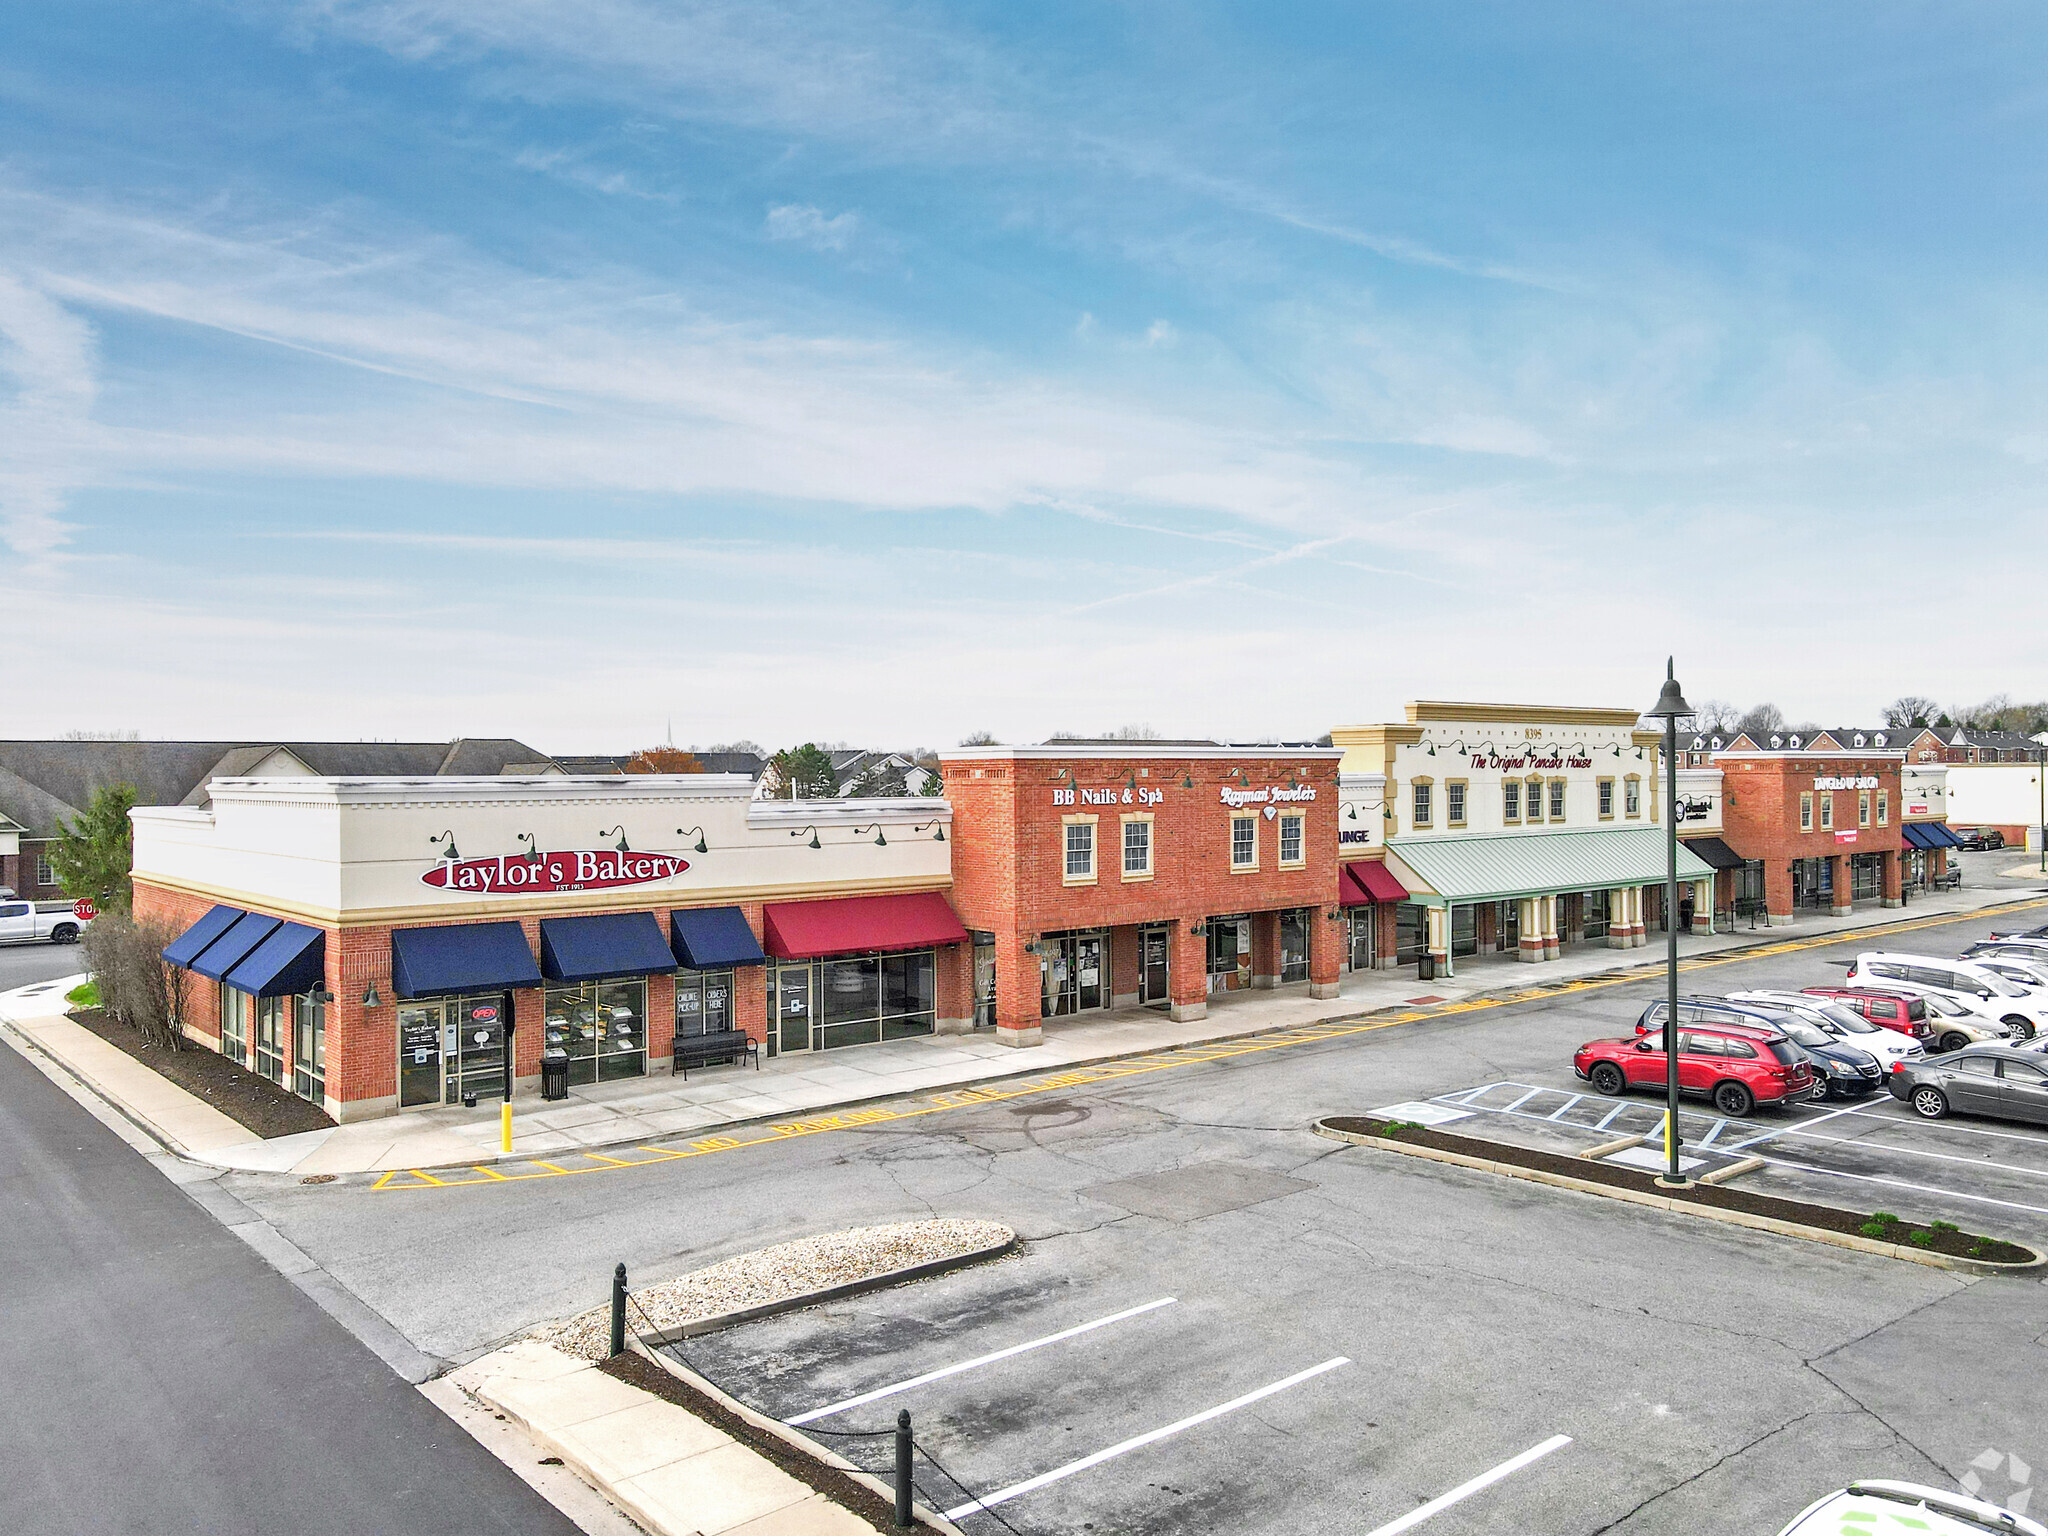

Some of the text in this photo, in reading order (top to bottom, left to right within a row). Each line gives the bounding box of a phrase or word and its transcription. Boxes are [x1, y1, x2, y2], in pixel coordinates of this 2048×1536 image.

[1524, 727, 1542, 739] 8395
[1471, 754, 1592, 773] The Original Pancake House
[1052, 787, 1164, 808] BB Nails & Spa
[1338, 830, 1370, 843] UNGE
[436, 850, 683, 894] Taylor's Bakery
[472, 1008, 497, 1019] OPEN
[689, 1108, 897, 1151] NO PARKING
